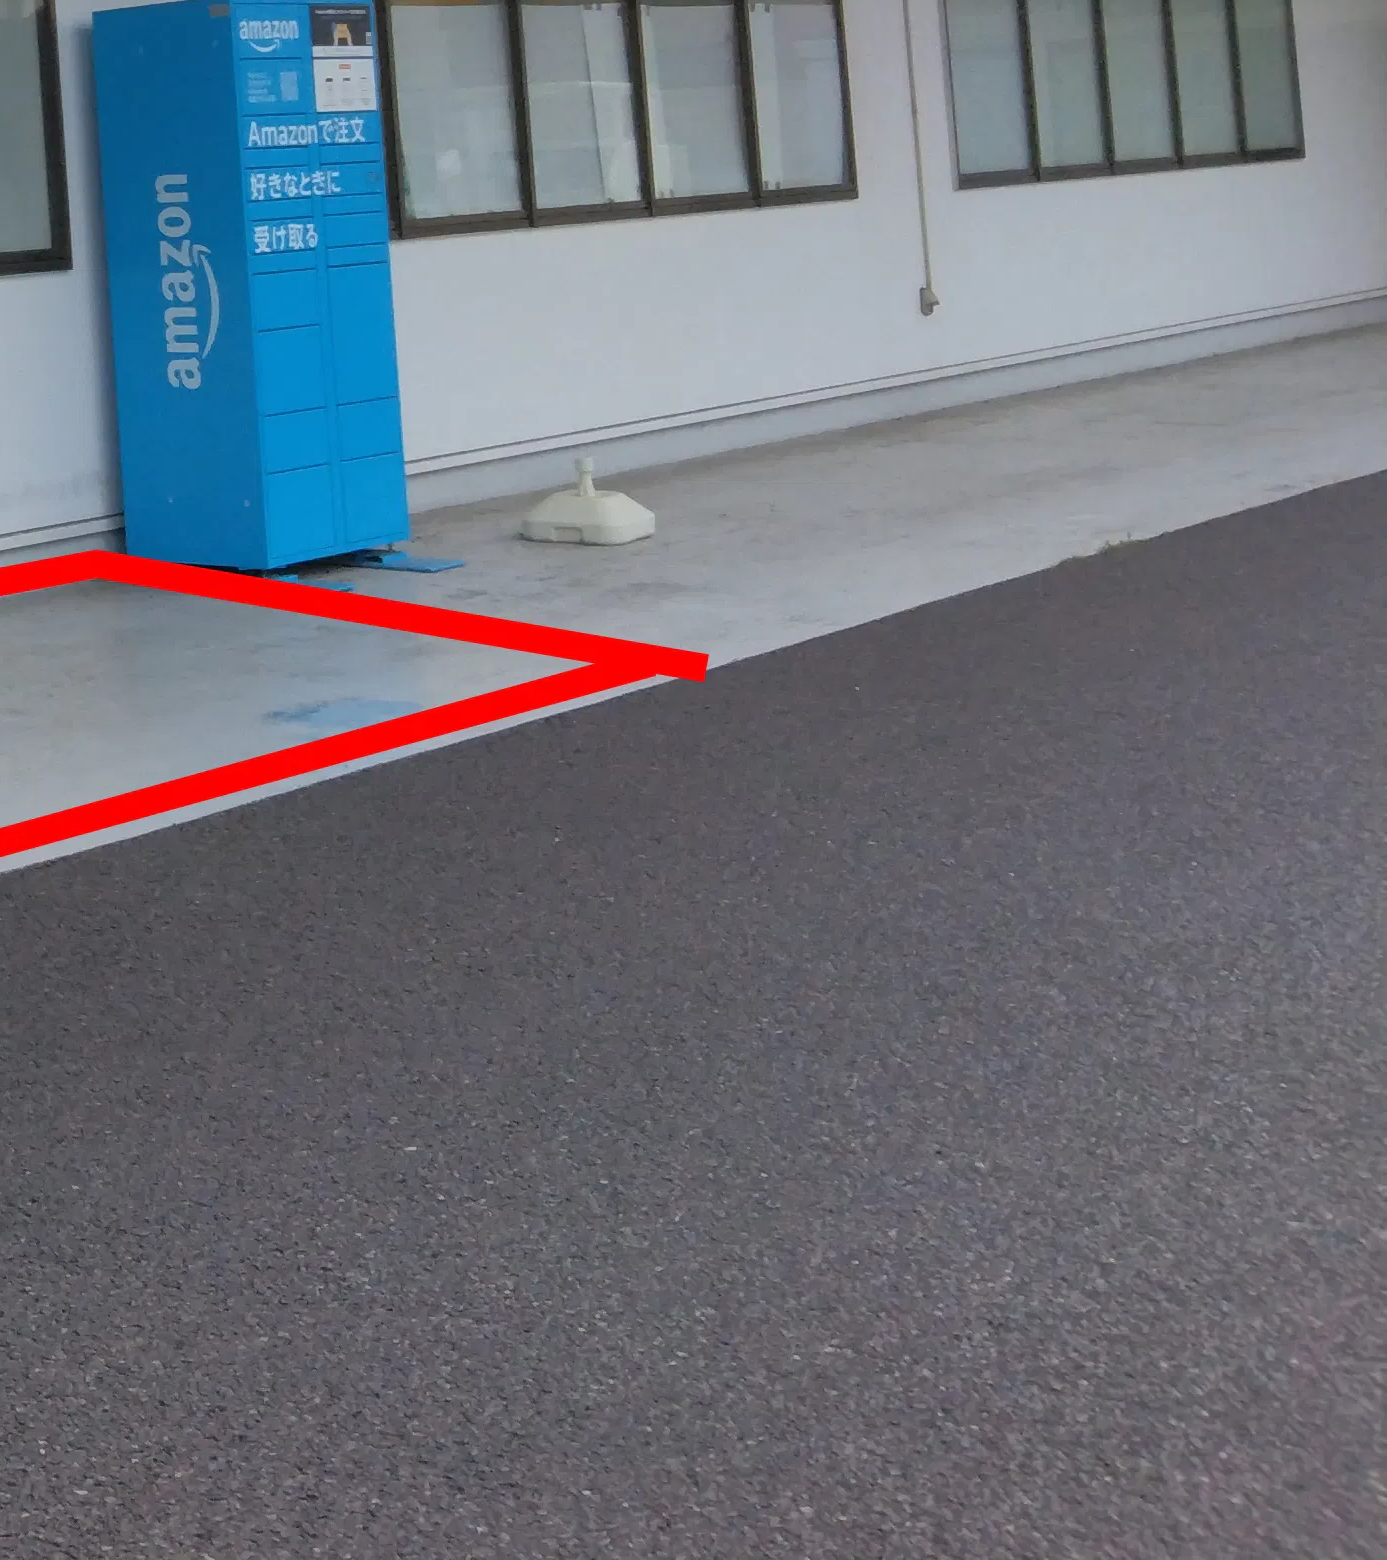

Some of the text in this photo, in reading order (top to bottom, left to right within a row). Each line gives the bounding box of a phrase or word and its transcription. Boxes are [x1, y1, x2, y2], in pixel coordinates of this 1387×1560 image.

[239, 20, 299, 41] amazon
[247, 116, 366, 148] Amazonで注文
[249, 171, 342, 202] 好きなときに
[253, 223, 320, 254] 受け取る
[154, 173, 202, 390] amazon
